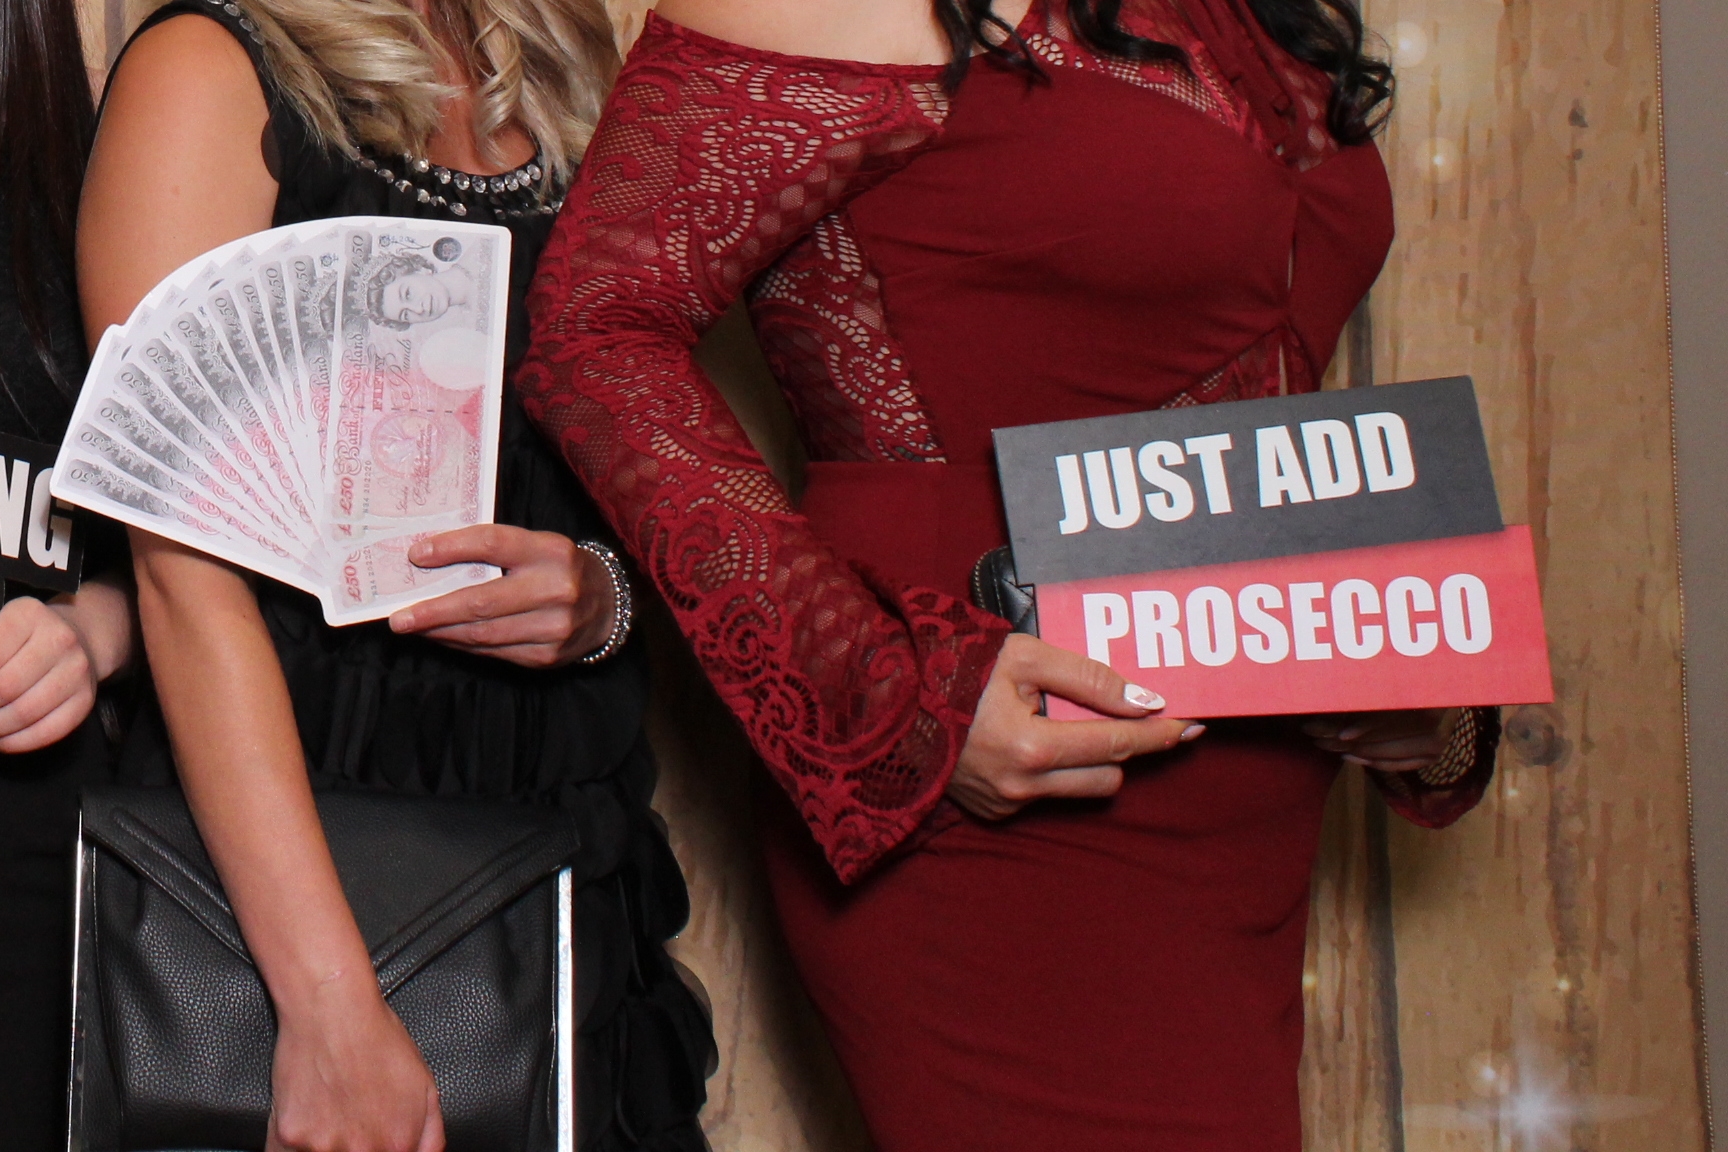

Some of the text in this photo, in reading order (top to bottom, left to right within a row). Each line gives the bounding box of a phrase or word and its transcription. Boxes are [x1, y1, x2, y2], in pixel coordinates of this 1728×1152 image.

[338, 332, 365, 405] England
[372, 353, 386, 412] FIFTY
[386, 338, 413, 403] Pounds
[333, 419, 361, 475] Bank
[1055, 411, 1415, 535] JUST ADD
[339, 476, 354, 515] £50
[345, 565, 362, 603] £50
[1082, 573, 1493, 669] PROSECCO
